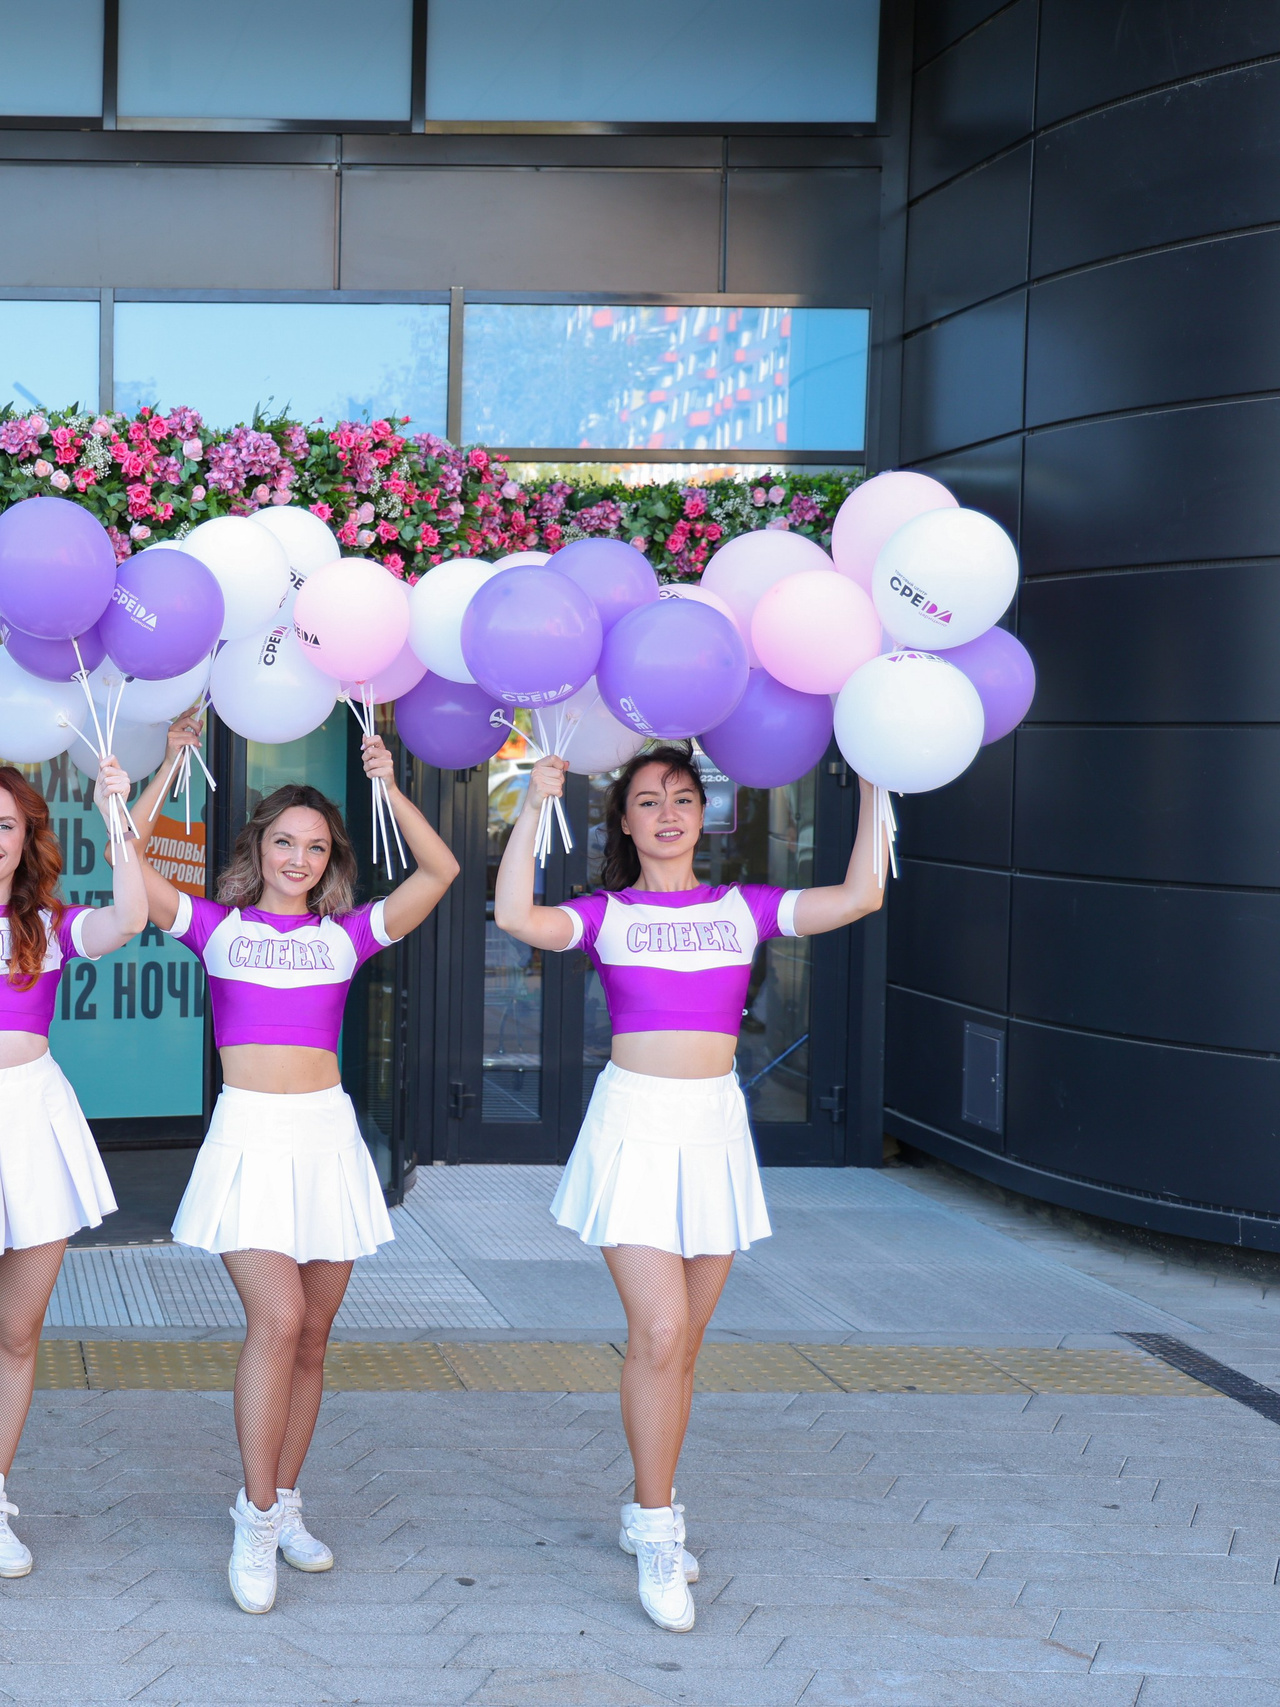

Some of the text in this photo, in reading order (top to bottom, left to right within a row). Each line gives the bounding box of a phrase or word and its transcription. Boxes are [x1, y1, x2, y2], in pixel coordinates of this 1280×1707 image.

[145, 835, 206, 864] РУППОВЫ
[228, 935, 335, 971] CHEER
[626, 920, 743, 954] CHEER
